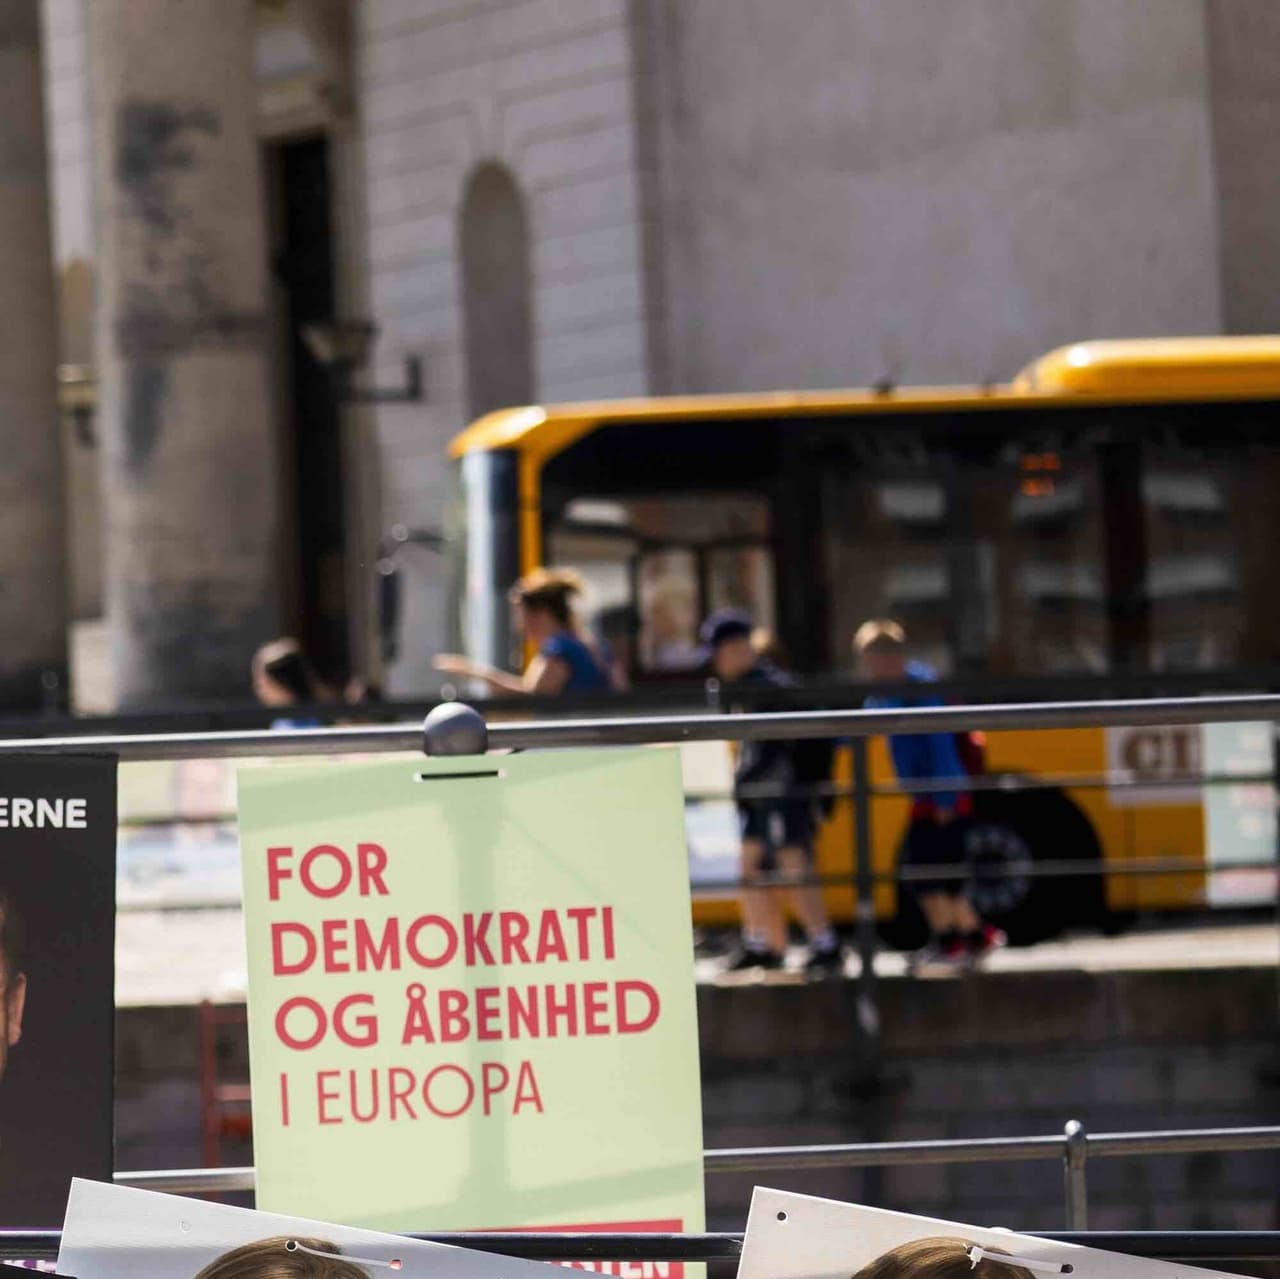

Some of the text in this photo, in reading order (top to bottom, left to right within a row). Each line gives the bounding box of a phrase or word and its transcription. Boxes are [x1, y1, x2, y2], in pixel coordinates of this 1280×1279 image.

[266, 842, 390, 901] FOR
[270, 905, 616, 977] DEMOKRATI
[274, 979, 661, 1051] OG ÅBENHED
[279, 1059, 545, 1127] I EUROPA
